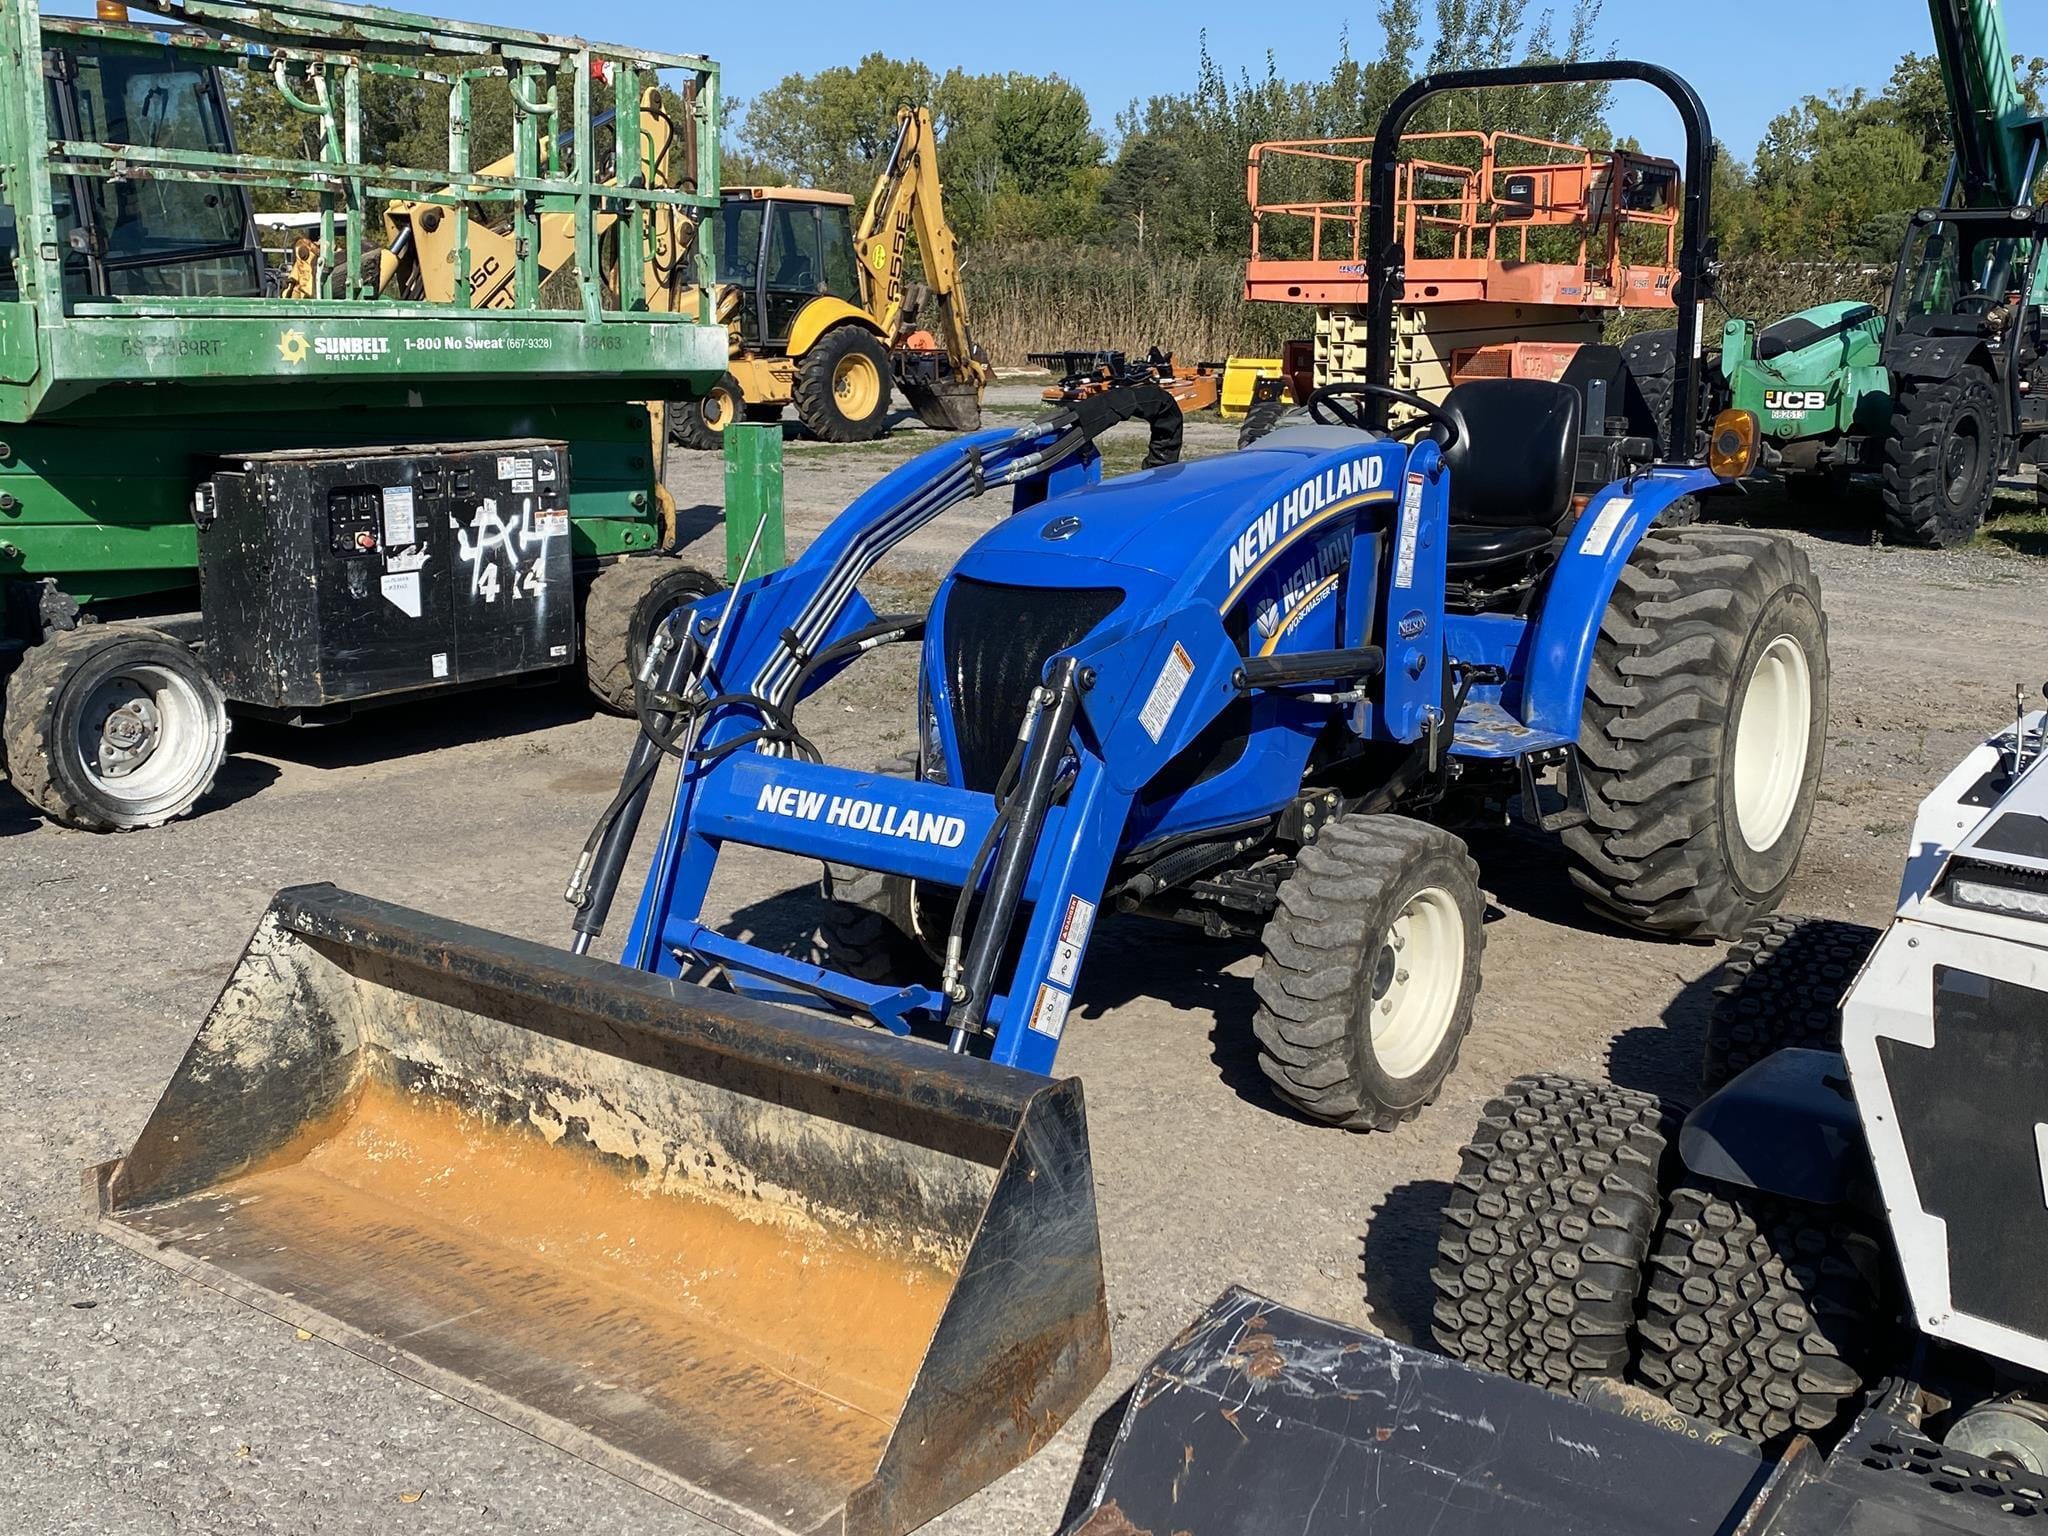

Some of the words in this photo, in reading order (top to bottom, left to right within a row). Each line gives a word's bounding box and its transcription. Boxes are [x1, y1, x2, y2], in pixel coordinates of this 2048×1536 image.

[314, 337, 389, 353] SUNBELT
[404, 338, 439, 350] 1-800
[444, 337, 462, 349] No
[465, 336, 503, 349] Sweat
[507, 338, 552, 349] (667-9328)
[1765, 391, 1825, 408] JCB
[1229, 501, 1279, 589] NEW
[1282, 455, 1383, 534] HOLLAND
[1286, 587, 1331, 637] WORKMASTER
[756, 783, 827, 822] NEW
[826, 796, 966, 848] HOLLAND
[1065, 899, 1077, 930] DANGER
